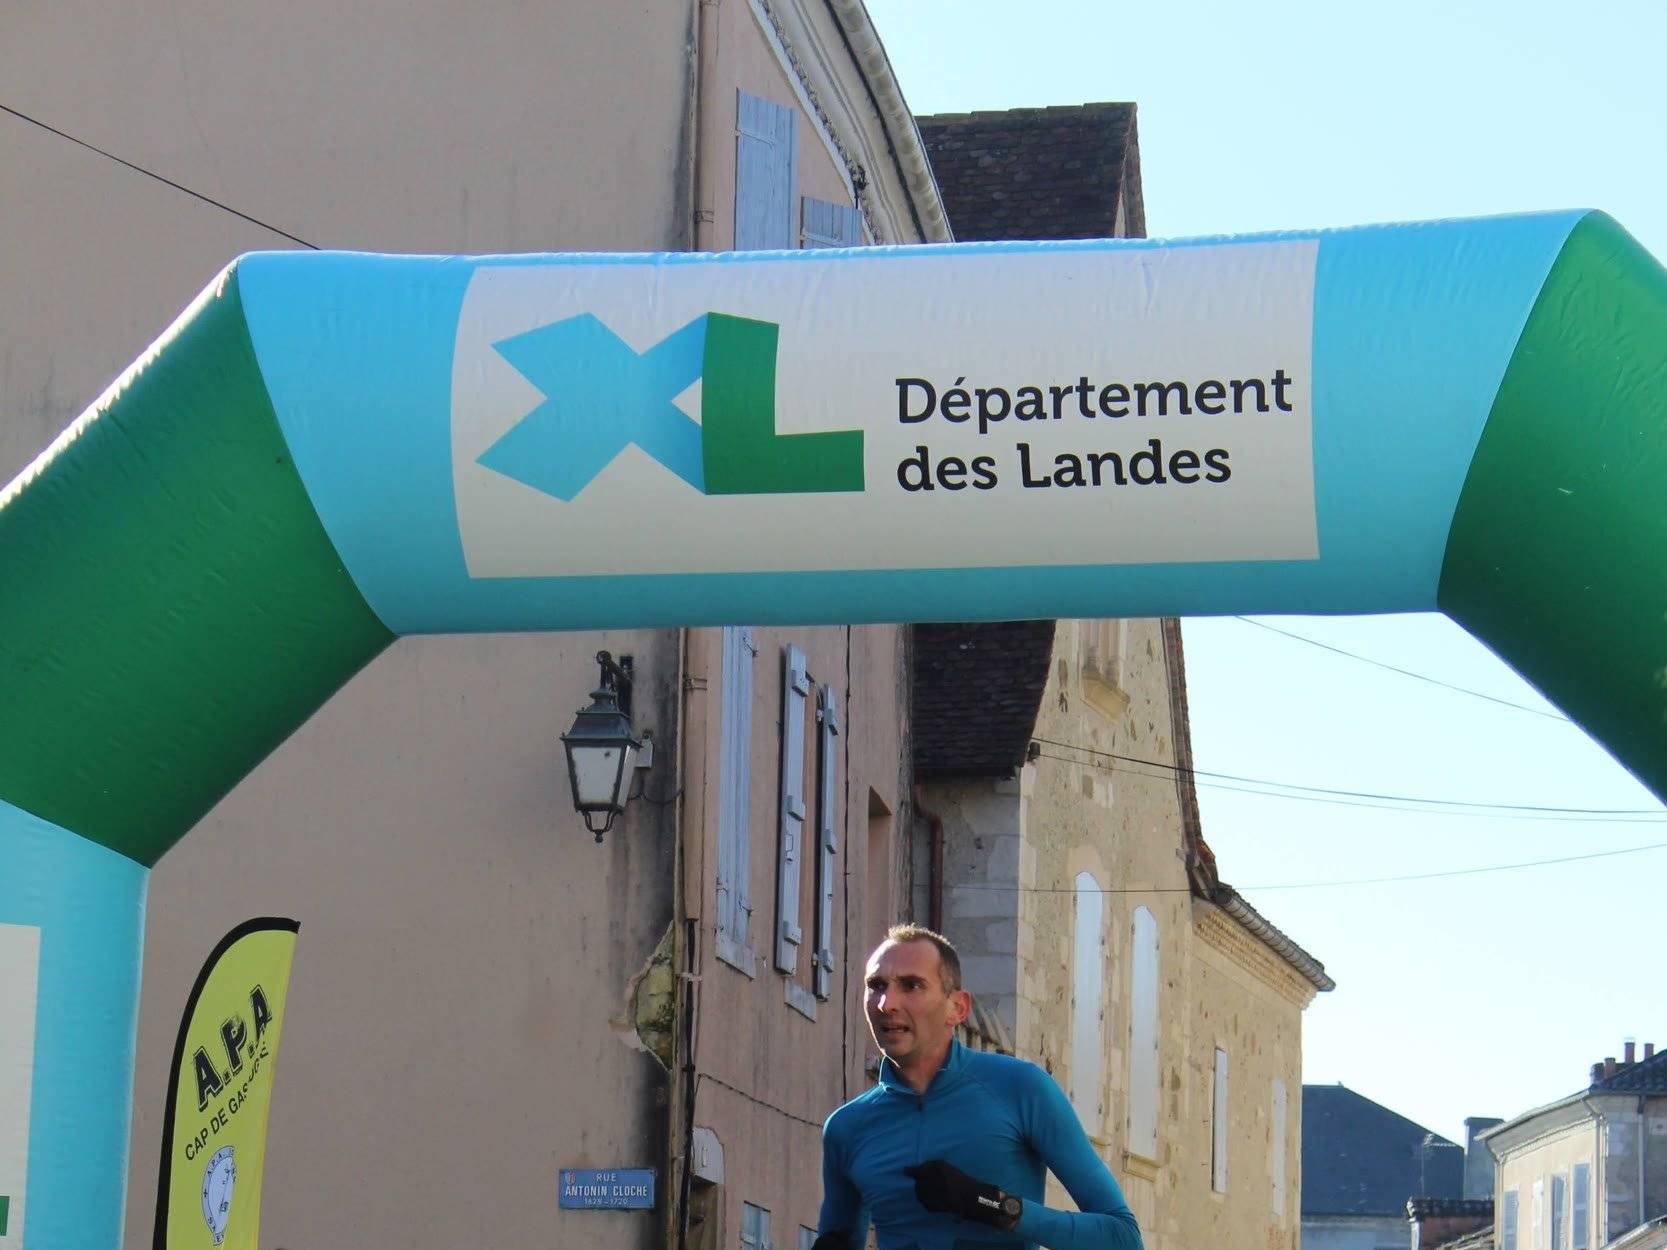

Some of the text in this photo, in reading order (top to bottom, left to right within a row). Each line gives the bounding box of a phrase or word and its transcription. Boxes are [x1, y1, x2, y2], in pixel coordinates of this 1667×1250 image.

[895, 368, 1293, 434] Département
[896, 437, 1233, 493] des Landes
[185, 1128, 209, 1161] CAP
[210, 1108, 229, 1135] DE
[565, 1185, 648, 1197] ANTONIN CLOCHE
[596, 1173, 617, 1182] RUE
